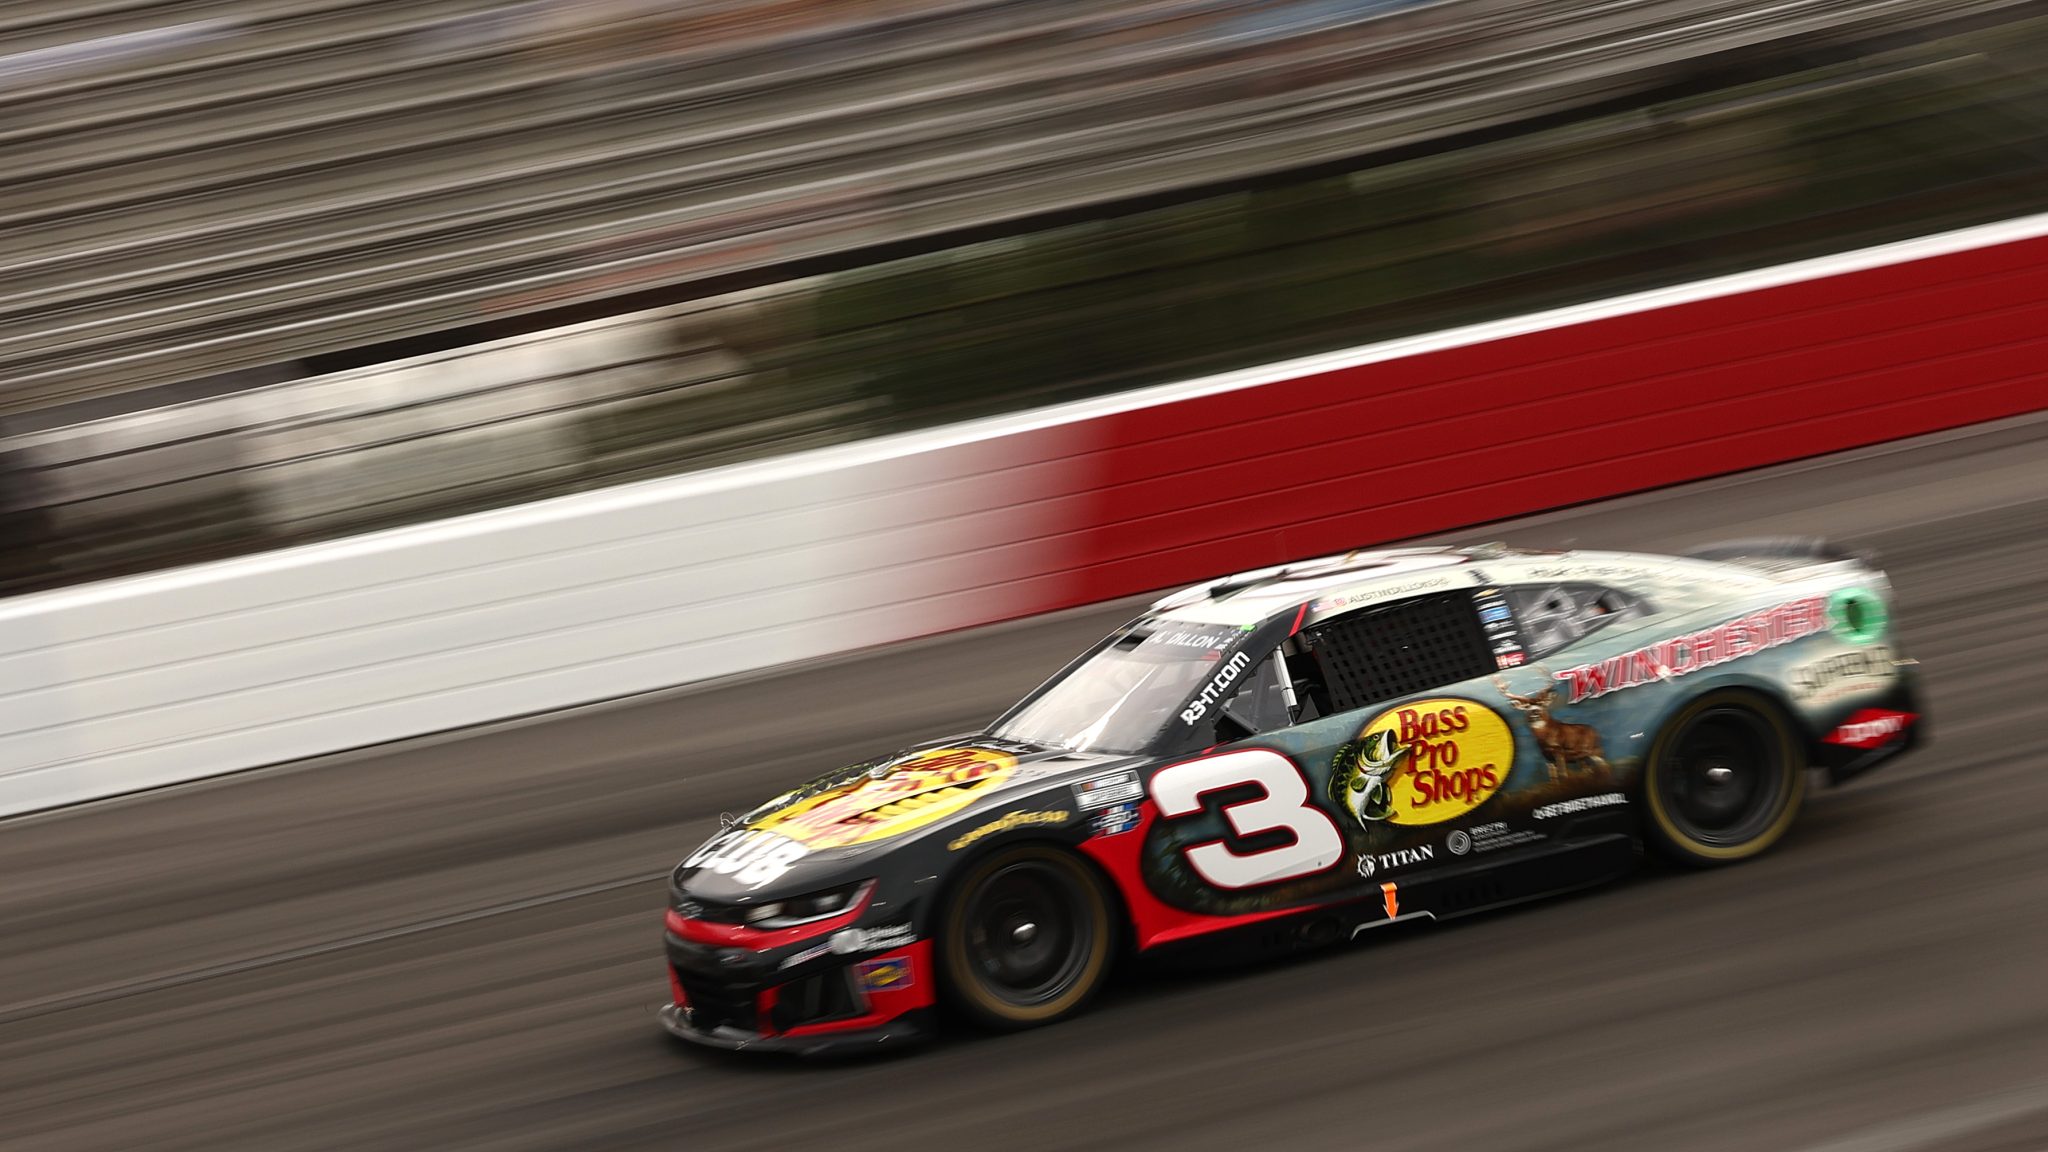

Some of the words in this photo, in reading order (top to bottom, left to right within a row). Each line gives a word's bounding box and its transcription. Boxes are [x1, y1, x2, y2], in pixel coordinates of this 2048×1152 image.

[1552, 592, 1832, 704] WINCHESTER
[1397, 705, 1470, 744] Bass
[1405, 738, 1459, 775] Pro
[1411, 763, 1500, 809] Shops
[1150, 748, 1346, 890] 3
[1380, 844, 1435, 870] TITAN
